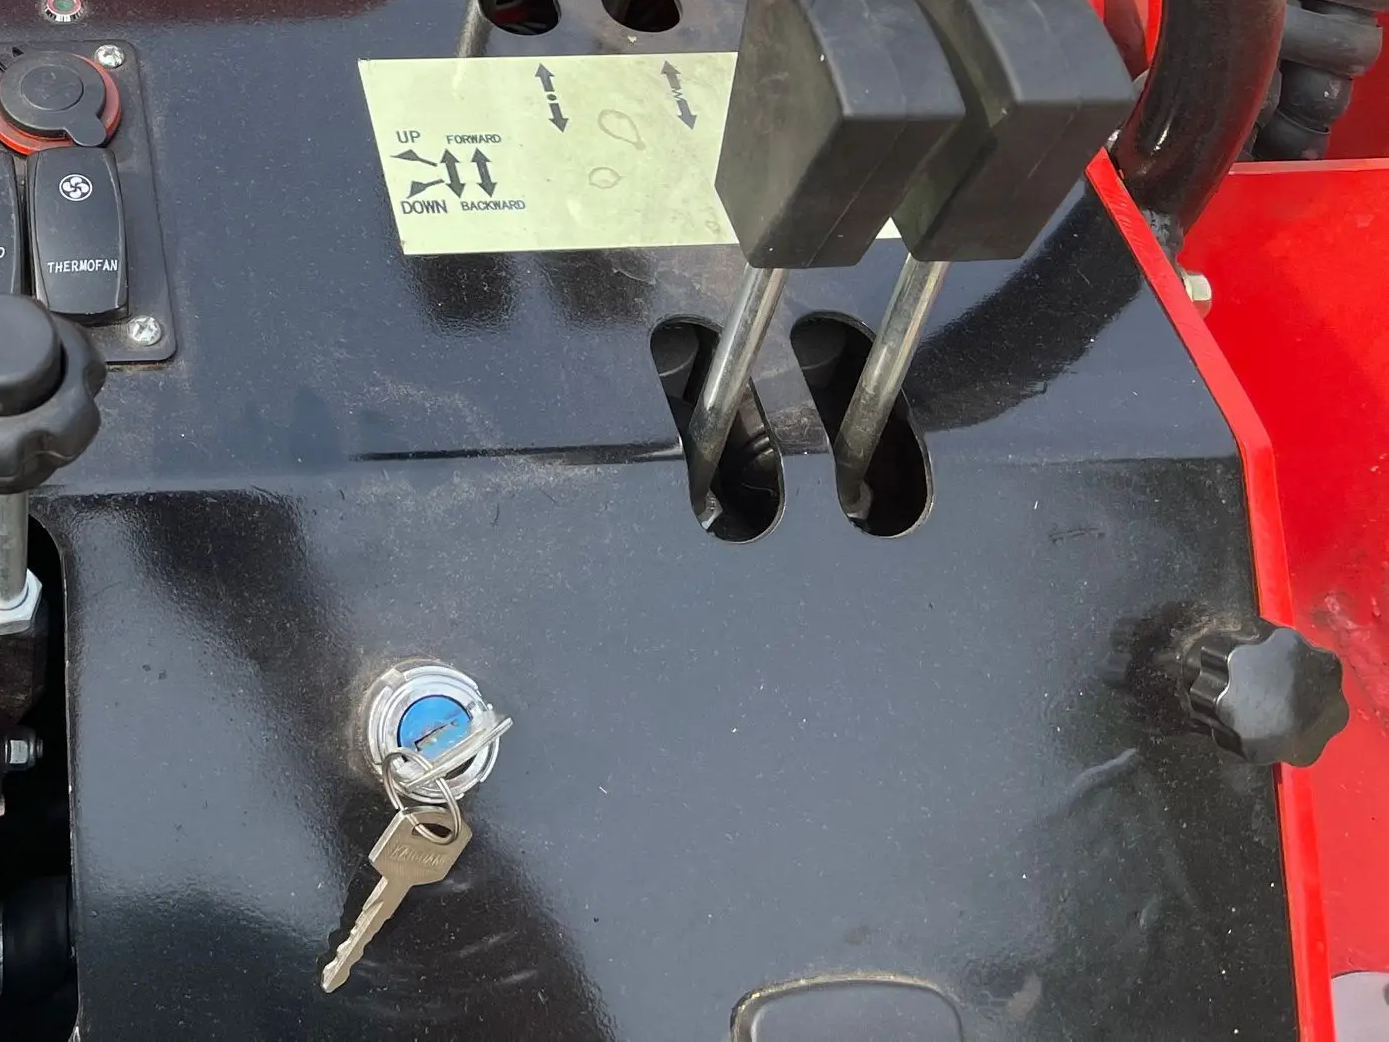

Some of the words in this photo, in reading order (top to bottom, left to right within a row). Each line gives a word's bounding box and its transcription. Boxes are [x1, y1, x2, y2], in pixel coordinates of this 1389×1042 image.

[396, 130, 421, 144] UP
[446, 133, 502, 145] FORWARD
[400, 199, 448, 214] DOWN
[460, 199, 526, 211] BACKWARD
[47, 259, 118, 273] THERMOFAN
